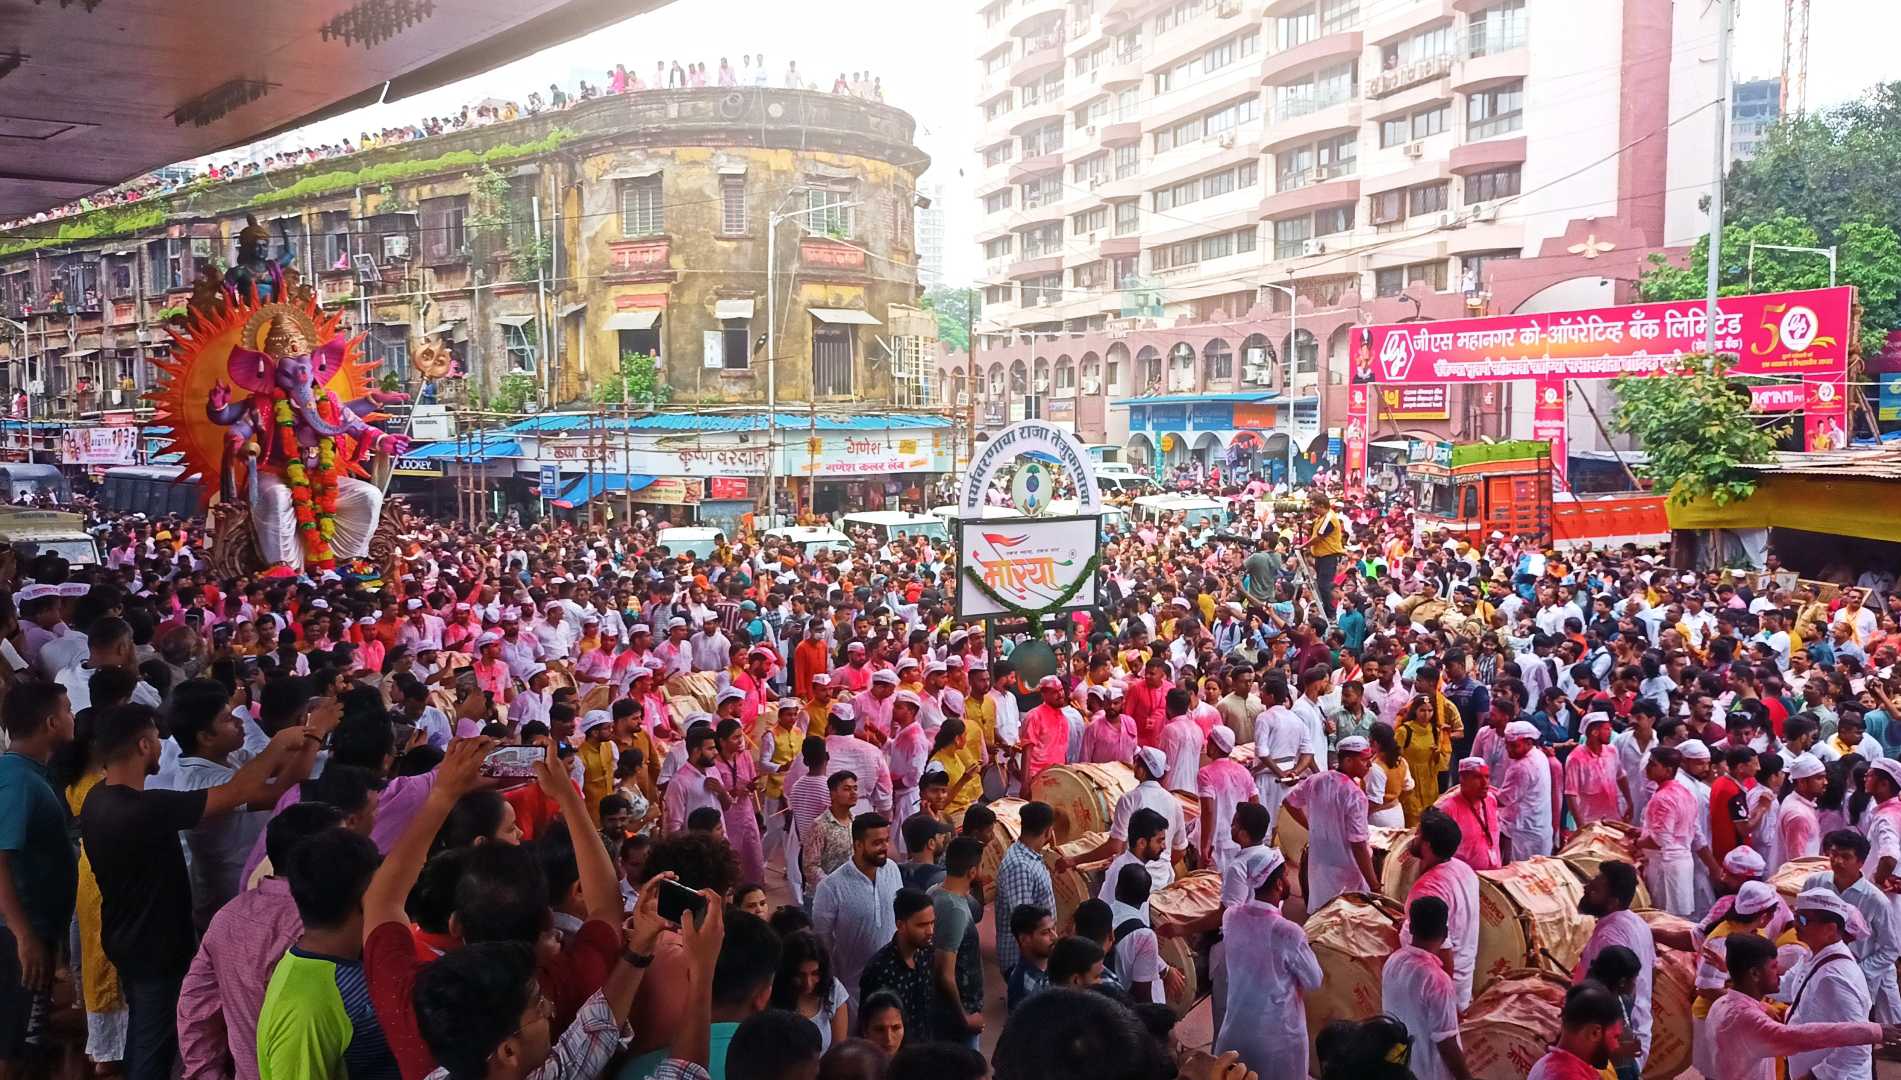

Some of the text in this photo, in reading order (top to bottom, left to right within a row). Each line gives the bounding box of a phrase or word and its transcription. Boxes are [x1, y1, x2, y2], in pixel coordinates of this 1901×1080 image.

[1457, 328, 1516, 351] महानगर
[1628, 309, 1660, 340] बँक
[1018, 425, 1050, 440] राजा
